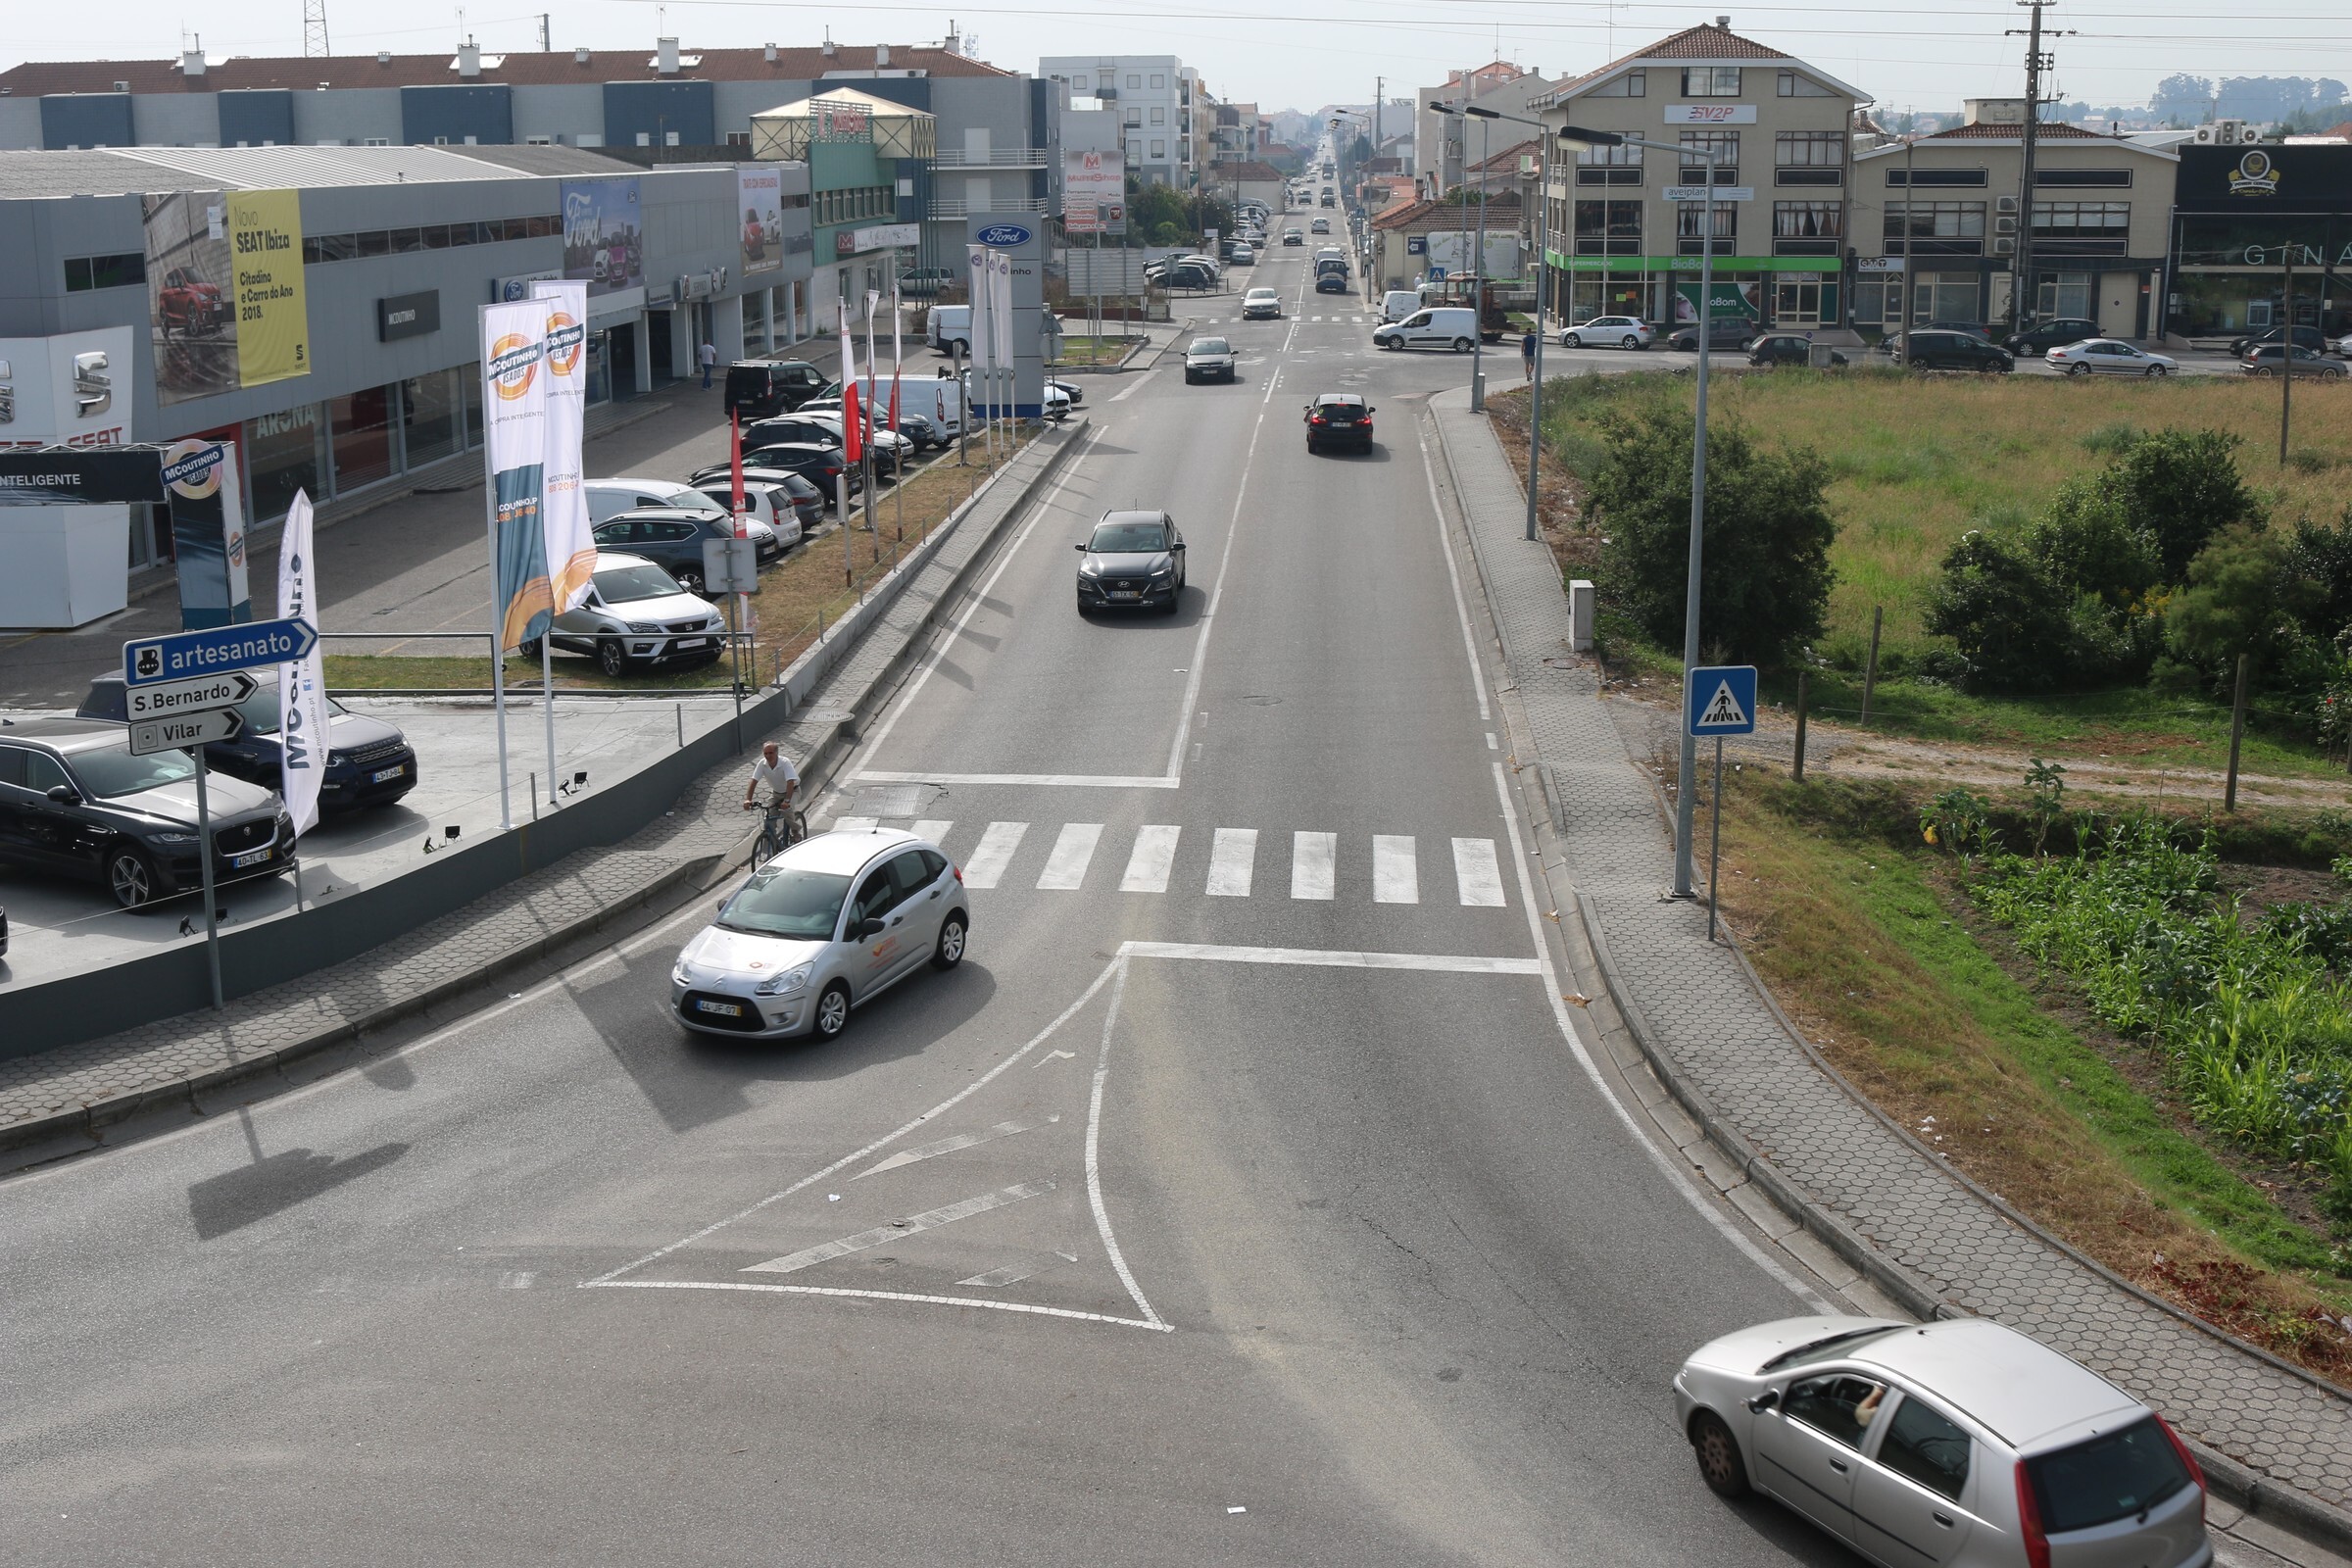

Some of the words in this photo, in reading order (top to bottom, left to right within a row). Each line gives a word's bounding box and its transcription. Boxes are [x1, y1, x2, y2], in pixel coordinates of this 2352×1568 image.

[234, 206, 259, 227] Novo
[236, 231, 264, 253] SEAT
[266, 228, 290, 252] Ibiza
[987, 227, 1020, 242] Ford
[1671, 259, 1713, 270] BioBo
[240, 270, 271, 286] Citadino
[241, 293, 246, 303] e
[247, 288, 270, 302] Carro
[270, 286, 279, 299] do
[279, 284, 293, 298] Ano
[1710, 297, 1737, 307] oBom
[242, 306, 264, 321] 2018.
[0, 474, 81, 486] NTELIGENTE
[172, 632, 292, 669] artesanato
[134, 683, 230, 712] S.Bernardo
[164, 723, 203, 741] Vilar
[309, 697, 325, 768] www.mcoutinho.pt
